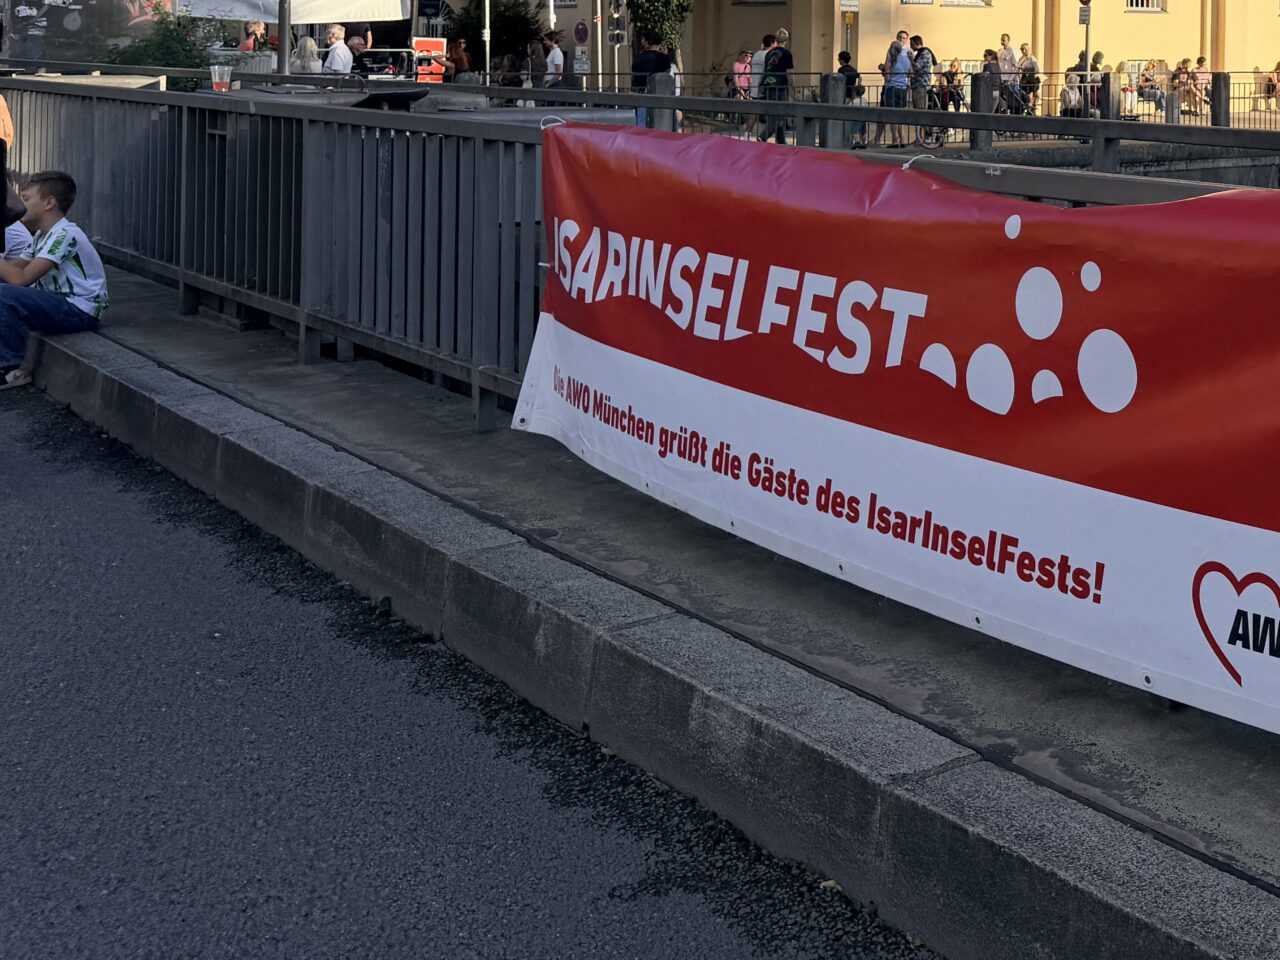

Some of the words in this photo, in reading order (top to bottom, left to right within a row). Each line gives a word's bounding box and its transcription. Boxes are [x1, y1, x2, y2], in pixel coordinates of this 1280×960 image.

[553, 216, 929, 375] ISARINSELFEST
[553, 364, 565, 398] Die
[565, 375, 591, 415] AWO
[592, 388, 655, 446] München
[658, 425, 708, 469] grüßt
[711, 440, 742, 481] die
[747, 451, 810, 507] Gäste
[815, 477, 861, 524] des
[866, 492, 1106, 605] IsarInselFests!
